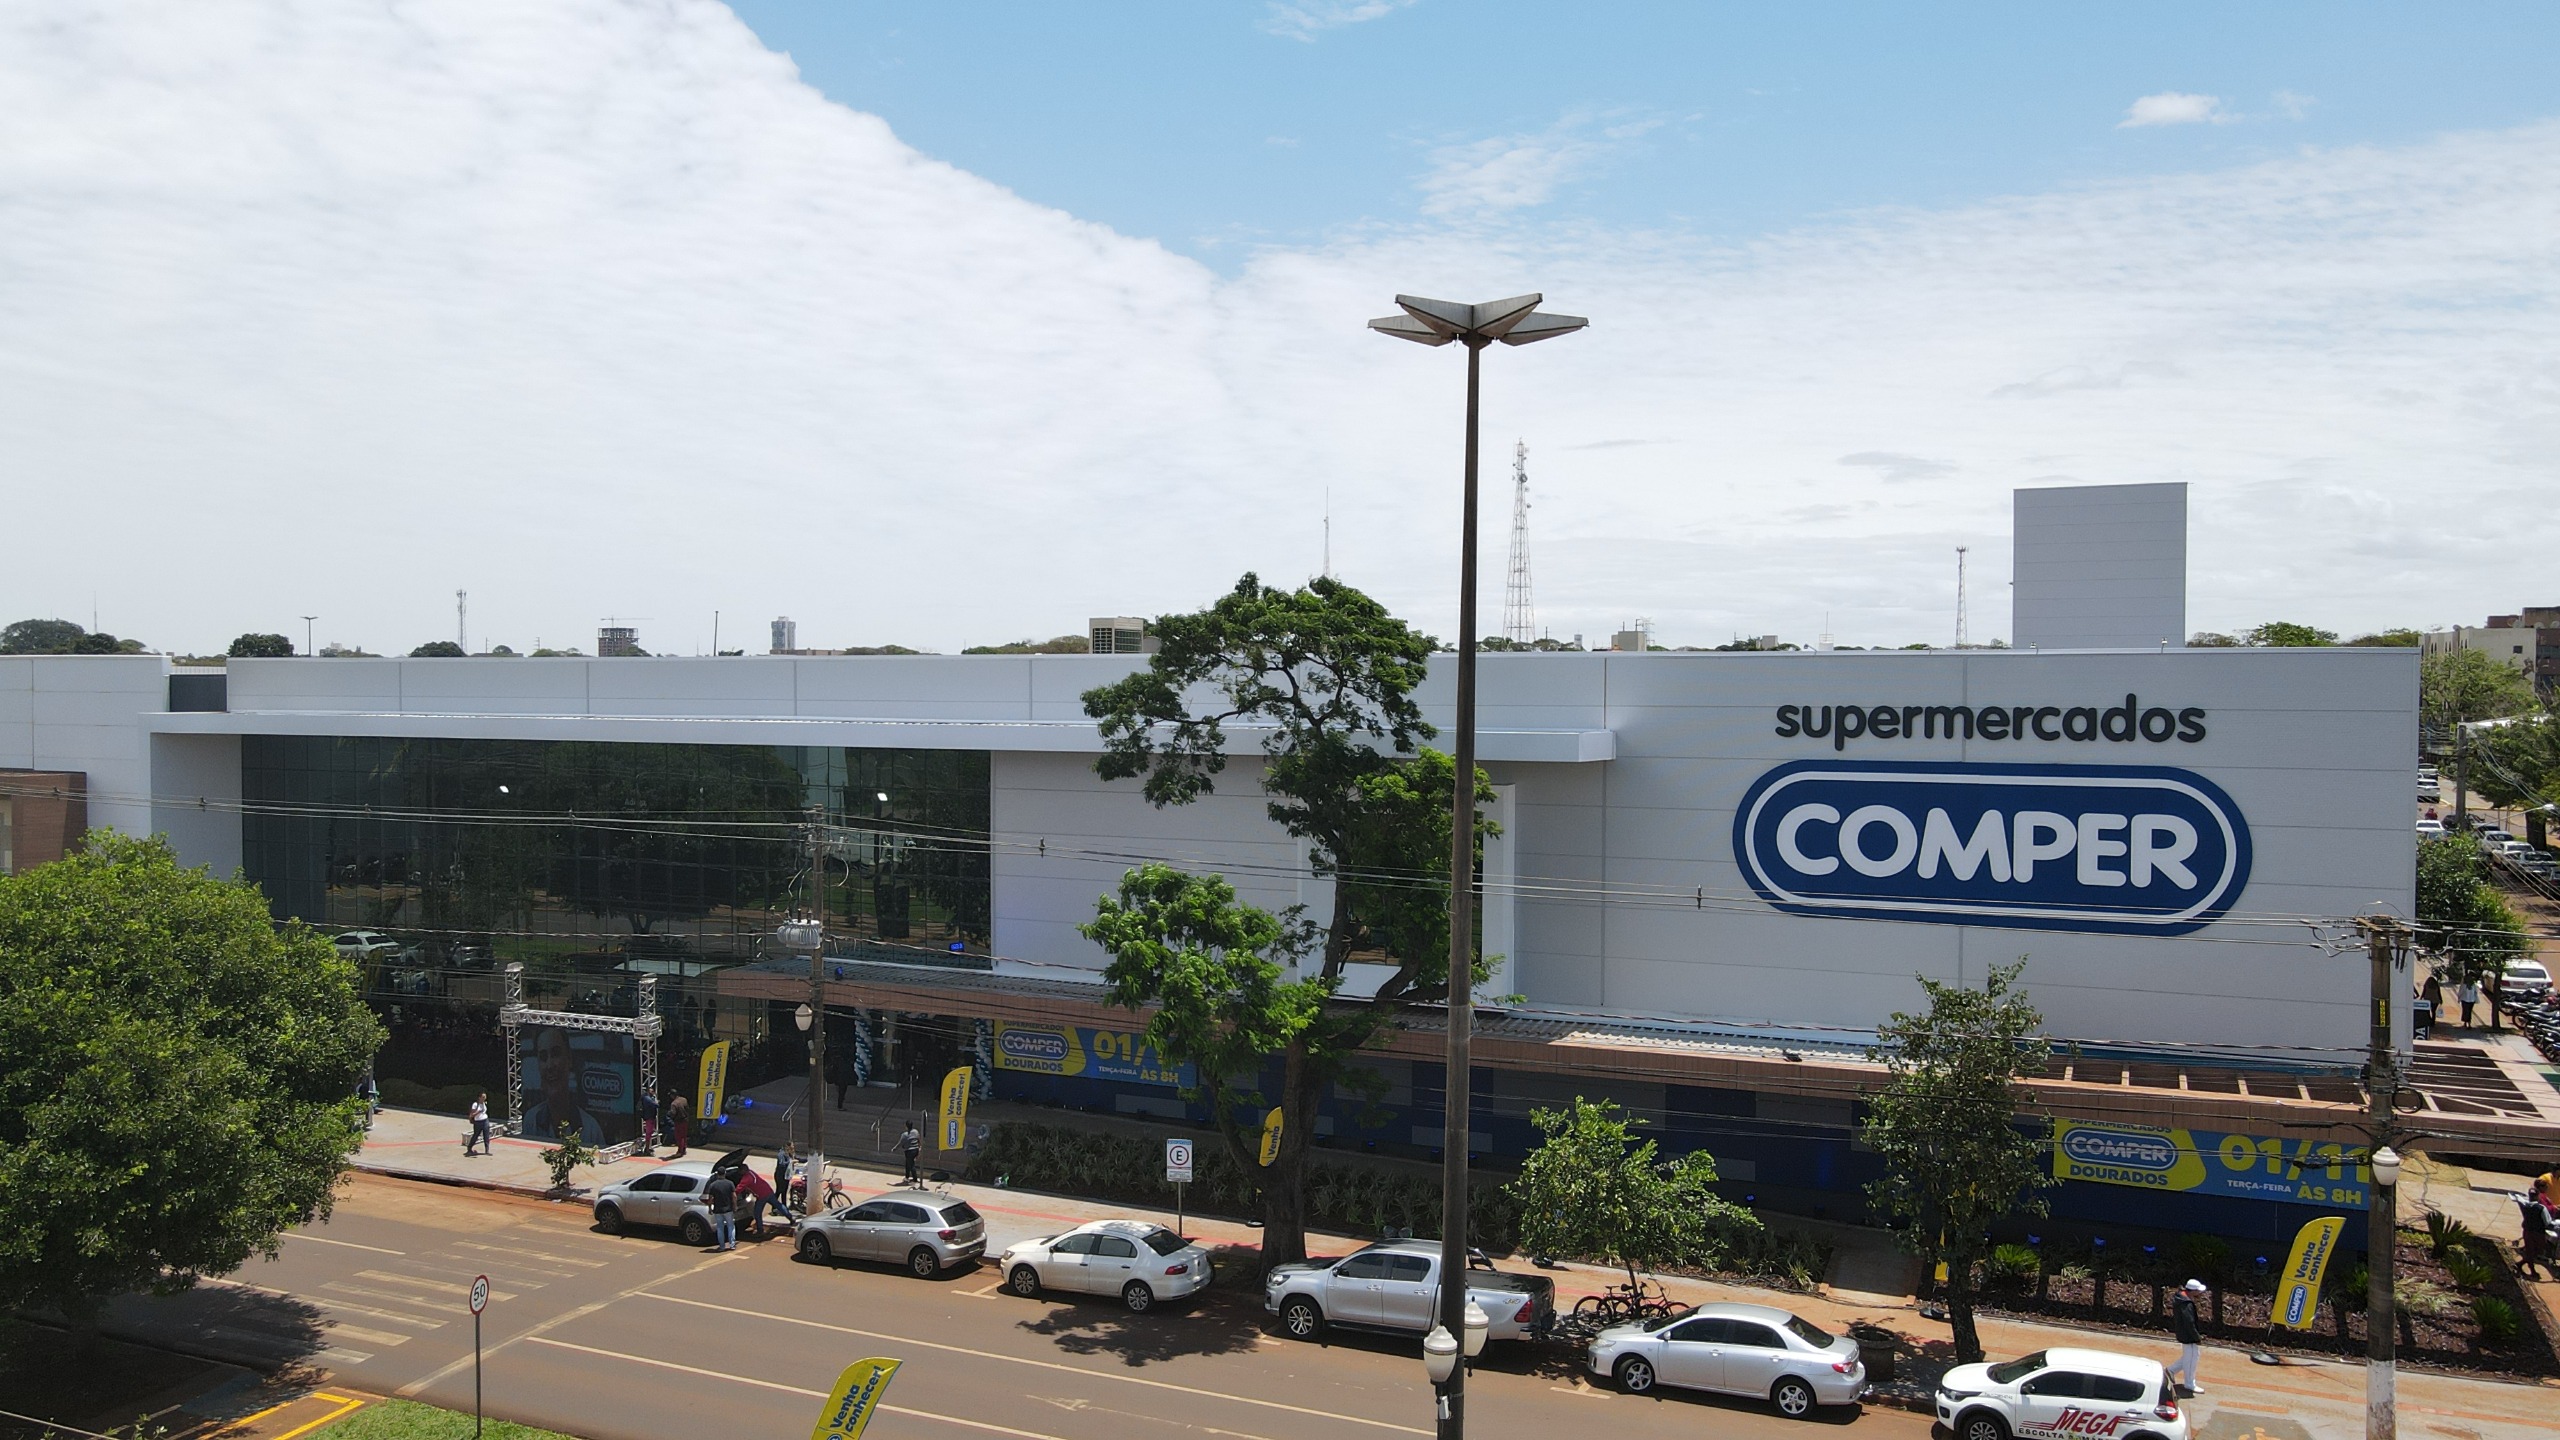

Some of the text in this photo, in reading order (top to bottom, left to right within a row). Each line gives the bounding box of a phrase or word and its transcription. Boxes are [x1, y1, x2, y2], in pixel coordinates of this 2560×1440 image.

[1775, 693, 2207, 751] supermercados
[1776, 803, 2198, 890] COMPER
[1004, 1035, 1063, 1054] COMPER
[705, 1060, 715, 1087] Venha
[1004, 1058, 1064, 1072] DOURADOS
[1161, 1071, 1178, 1083] 8H
[947, 1087, 957, 1115] Venha
[956, 1073, 966, 1116] conhecer!
[1267, 1125, 1280, 1156] Venha
[2071, 1136, 2167, 1162] COMPER
[1176, 1150, 1183, 1162] E
[2218, 1134, 2370, 1184] 01/11
[2070, 1165, 2168, 1186] DOURADOS
[2227, 1179, 2292, 1193] TERÇA-FEIRA
[2297, 1181, 2362, 1205] ÀS 8H
[2295, 1241, 2316, 1278] Venha
[2308, 1224, 2333, 1281] conhecer!
[473, 1283, 486, 1302] 50
[2288, 1287, 2305, 1321] COMPER
[830, 1384, 860, 1428] Venha
[845, 1365, 885, 1432] conhecer!
[2018, 1427, 2064, 1440] ESCOLTA
[2053, 1408, 2120, 1437] MEGA
